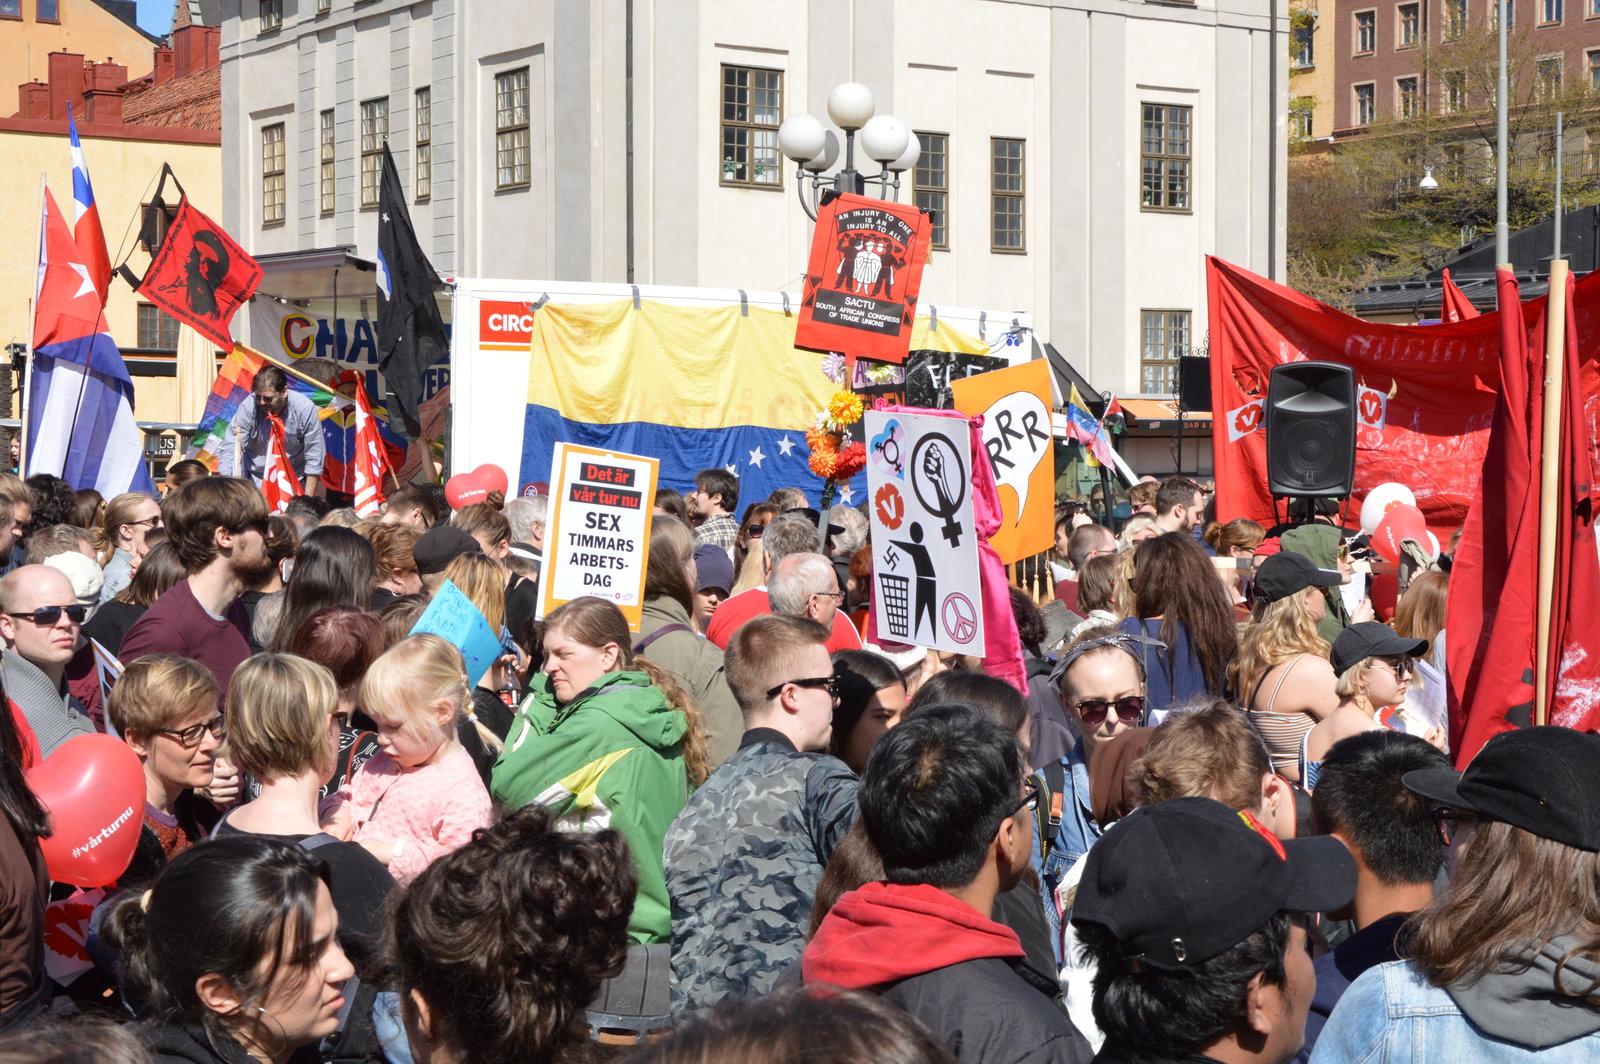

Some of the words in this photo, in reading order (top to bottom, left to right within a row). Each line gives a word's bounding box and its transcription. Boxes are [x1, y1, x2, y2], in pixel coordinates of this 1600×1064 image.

[838, 213, 849, 221] AN
[885, 214, 894, 222] TO
[898, 220, 913, 235] ONE
[876, 219, 887, 227] AN
[877, 225, 887, 233] TO
[889, 230, 901, 242] ALL
[844, 297, 876, 310] SACTU
[815, 302, 837, 311] SOUTH
[839, 305, 865, 317] AFRICAN
[867, 312, 901, 324] CONGRESS
[829, 311, 838, 319] OF
[840, 313, 860, 323] TRADE
[861, 318, 885, 328] UNIONS
[1365, 400, 1377, 416] V
[1241, 411, 1255, 426] V
[586, 465, 612, 482] Det
[614, 468, 630, 484] är
[572, 486, 596, 502] vår
[598, 489, 619, 505] tur
[621, 495, 639, 508] nu
[881, 494, 897, 519] V
[584, 511, 622, 533] SEX
[568, 532, 635, 553] TIMMARS
[569, 552, 629, 570] ARBETS-
[583, 572, 612, 588] DAG
[72, 806, 134, 859] #vårturnu
